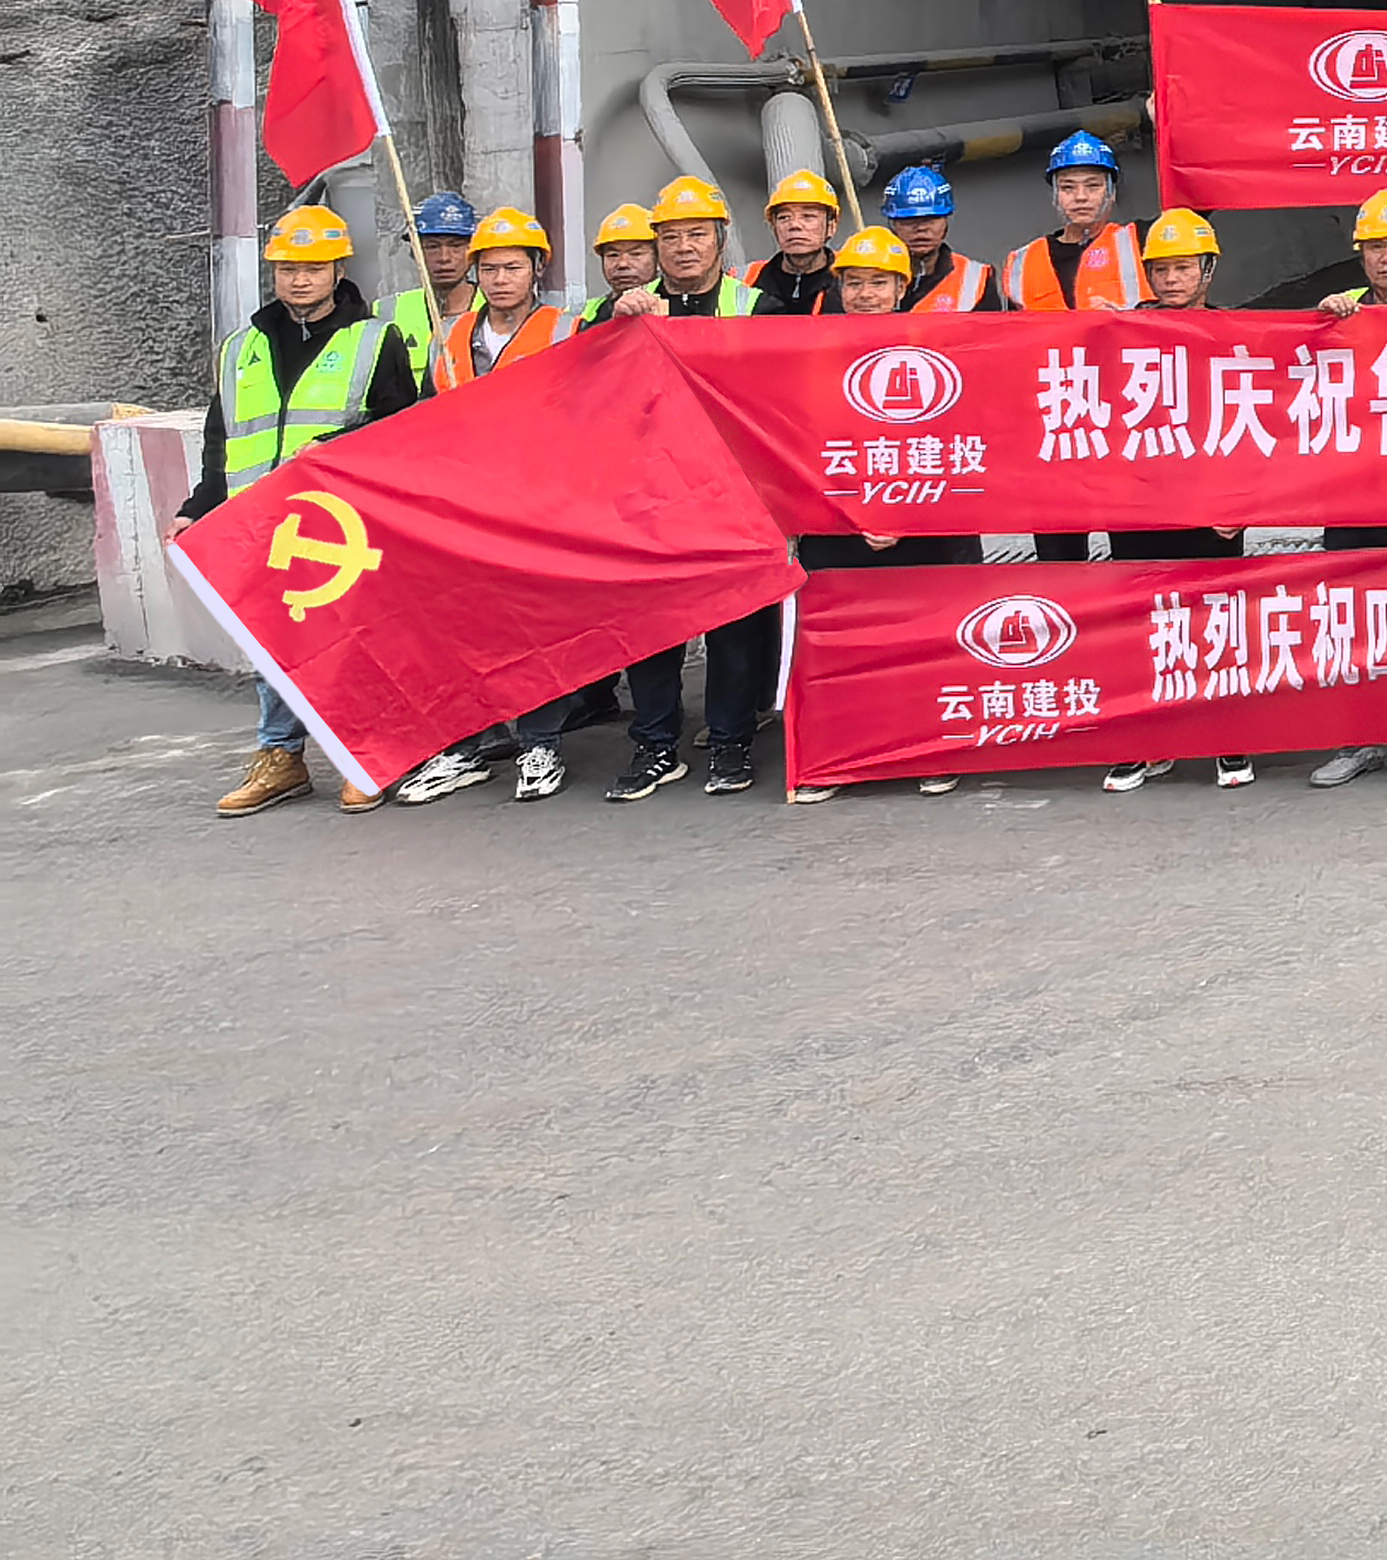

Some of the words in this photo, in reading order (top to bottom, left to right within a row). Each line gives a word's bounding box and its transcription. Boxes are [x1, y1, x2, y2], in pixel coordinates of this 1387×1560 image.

[820, 435, 988, 477] 云南建投
[861, 480, 947, 505] YCIH
[936, 677, 1102, 722] 云南建投
[976, 722, 1061, 747] YCIH
